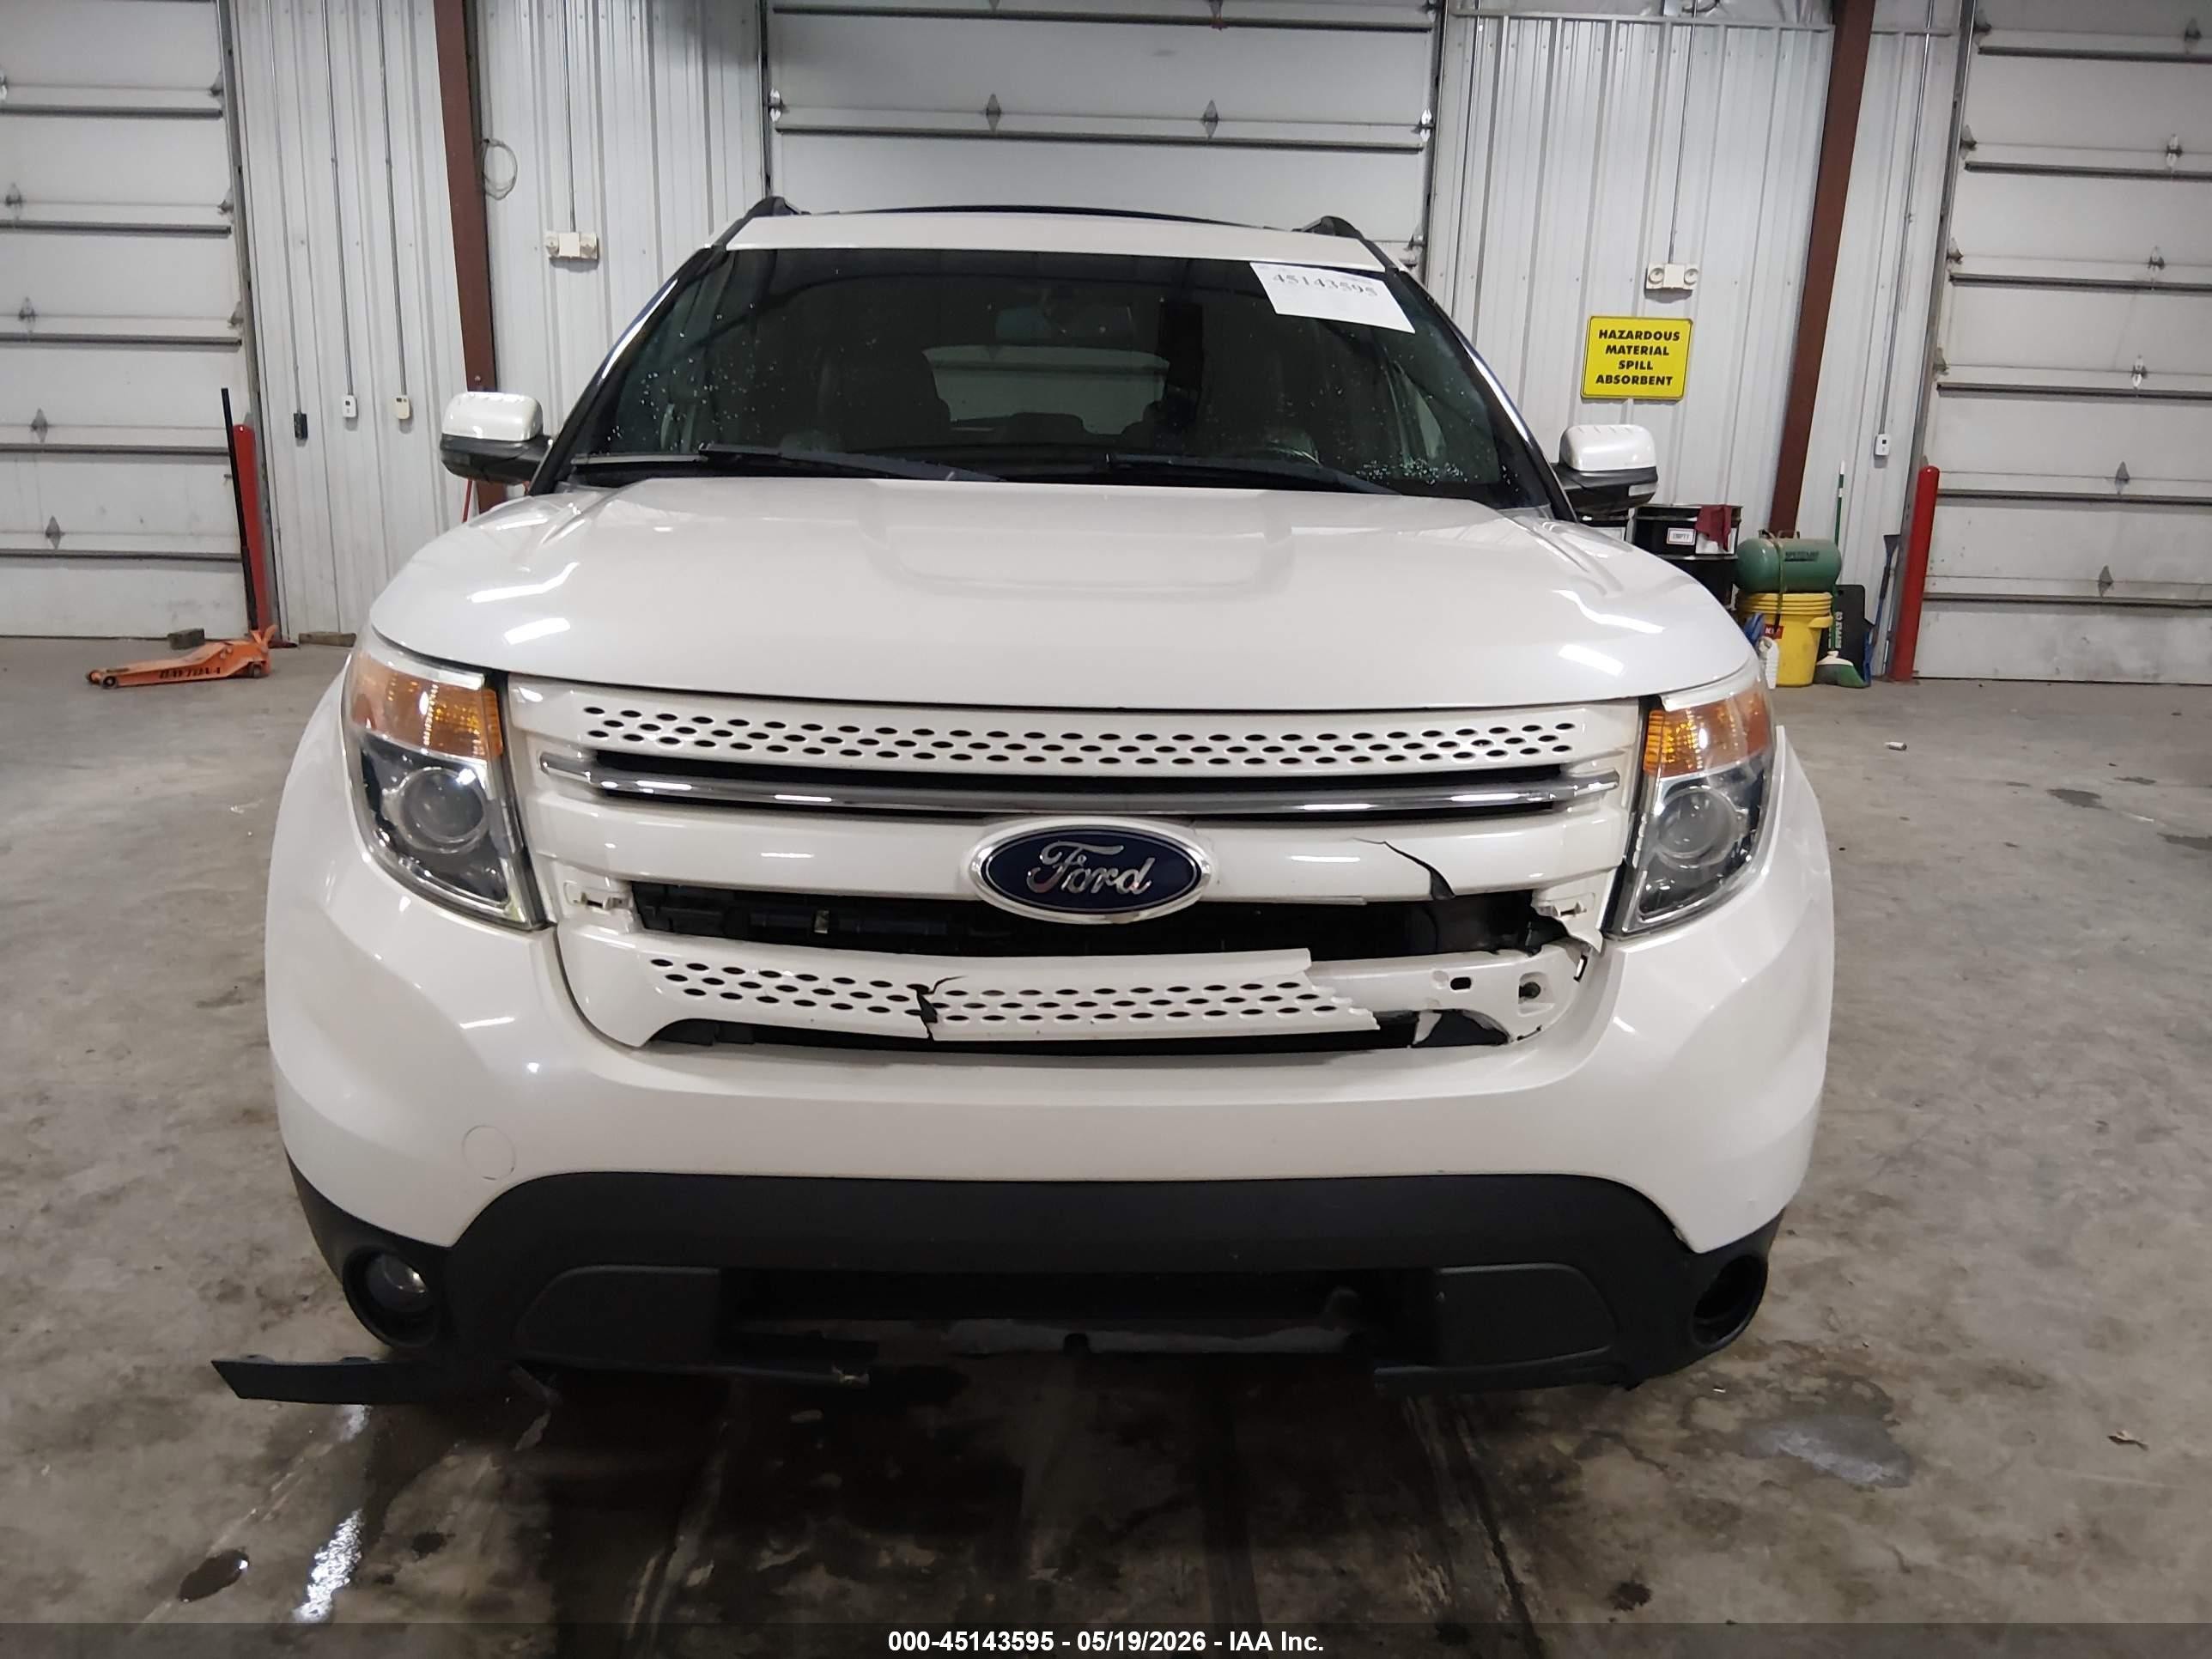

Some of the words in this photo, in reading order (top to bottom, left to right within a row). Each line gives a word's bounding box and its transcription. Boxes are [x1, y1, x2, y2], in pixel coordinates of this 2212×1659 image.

[1273, 274, 1377, 296] 45143595
[1598, 329, 1680, 342] HAZARDOUS
[1605, 344, 1670, 356] MATERIAL
[1618, 360, 1654, 370] SPILL
[1595, 374, 1674, 386] ABSORBENT
[1026, 840, 1156, 895] Ford
